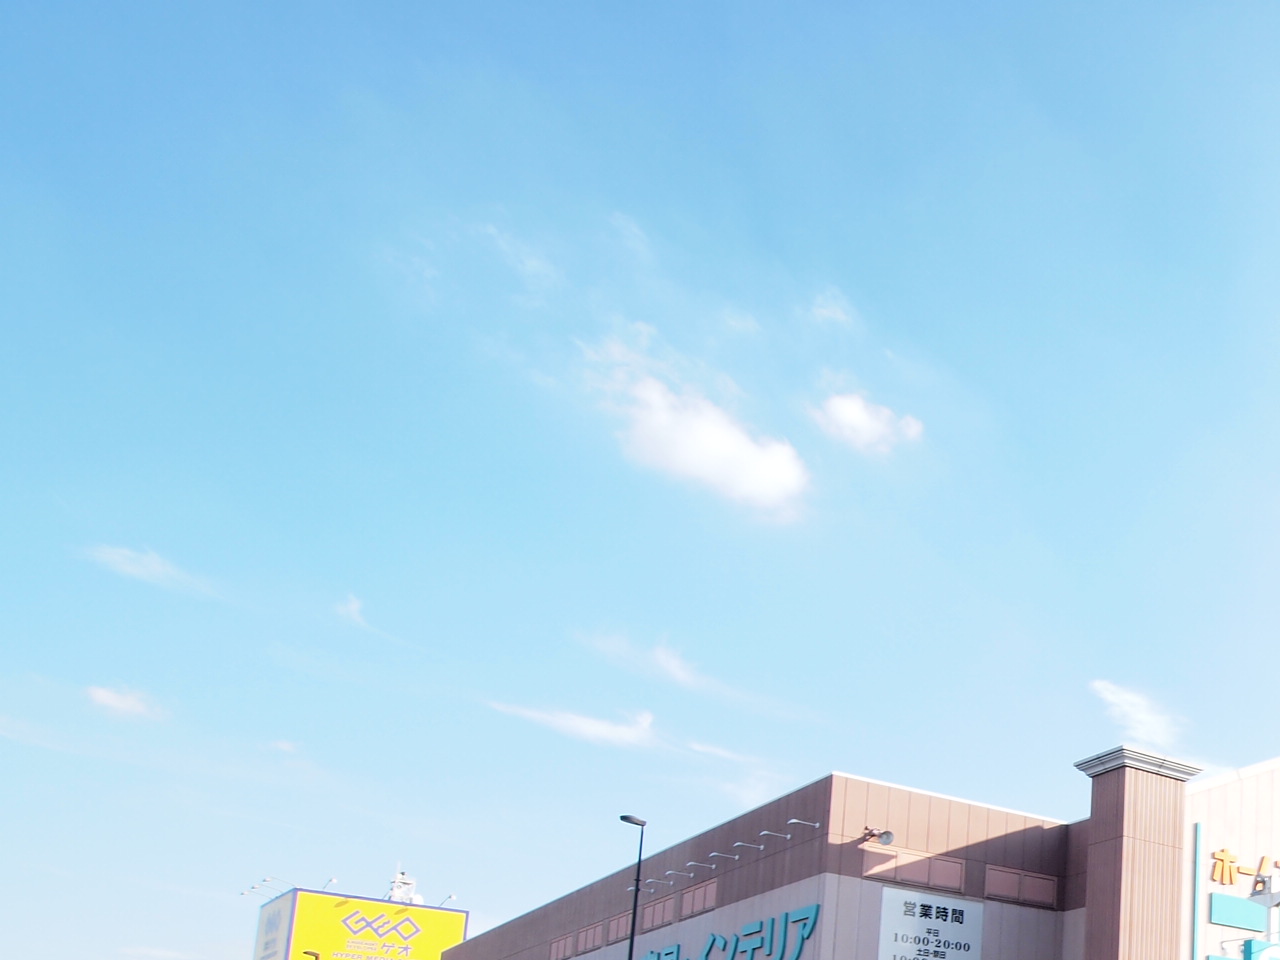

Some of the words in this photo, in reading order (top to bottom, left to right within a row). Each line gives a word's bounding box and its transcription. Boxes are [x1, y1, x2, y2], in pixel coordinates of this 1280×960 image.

[903, 901, 964, 925] 営業時間
[380, 942, 412, 957] ゲオ
[893, 932, 971, 952] 10:00-20:00
[332, 951, 363, 960] HYPER
